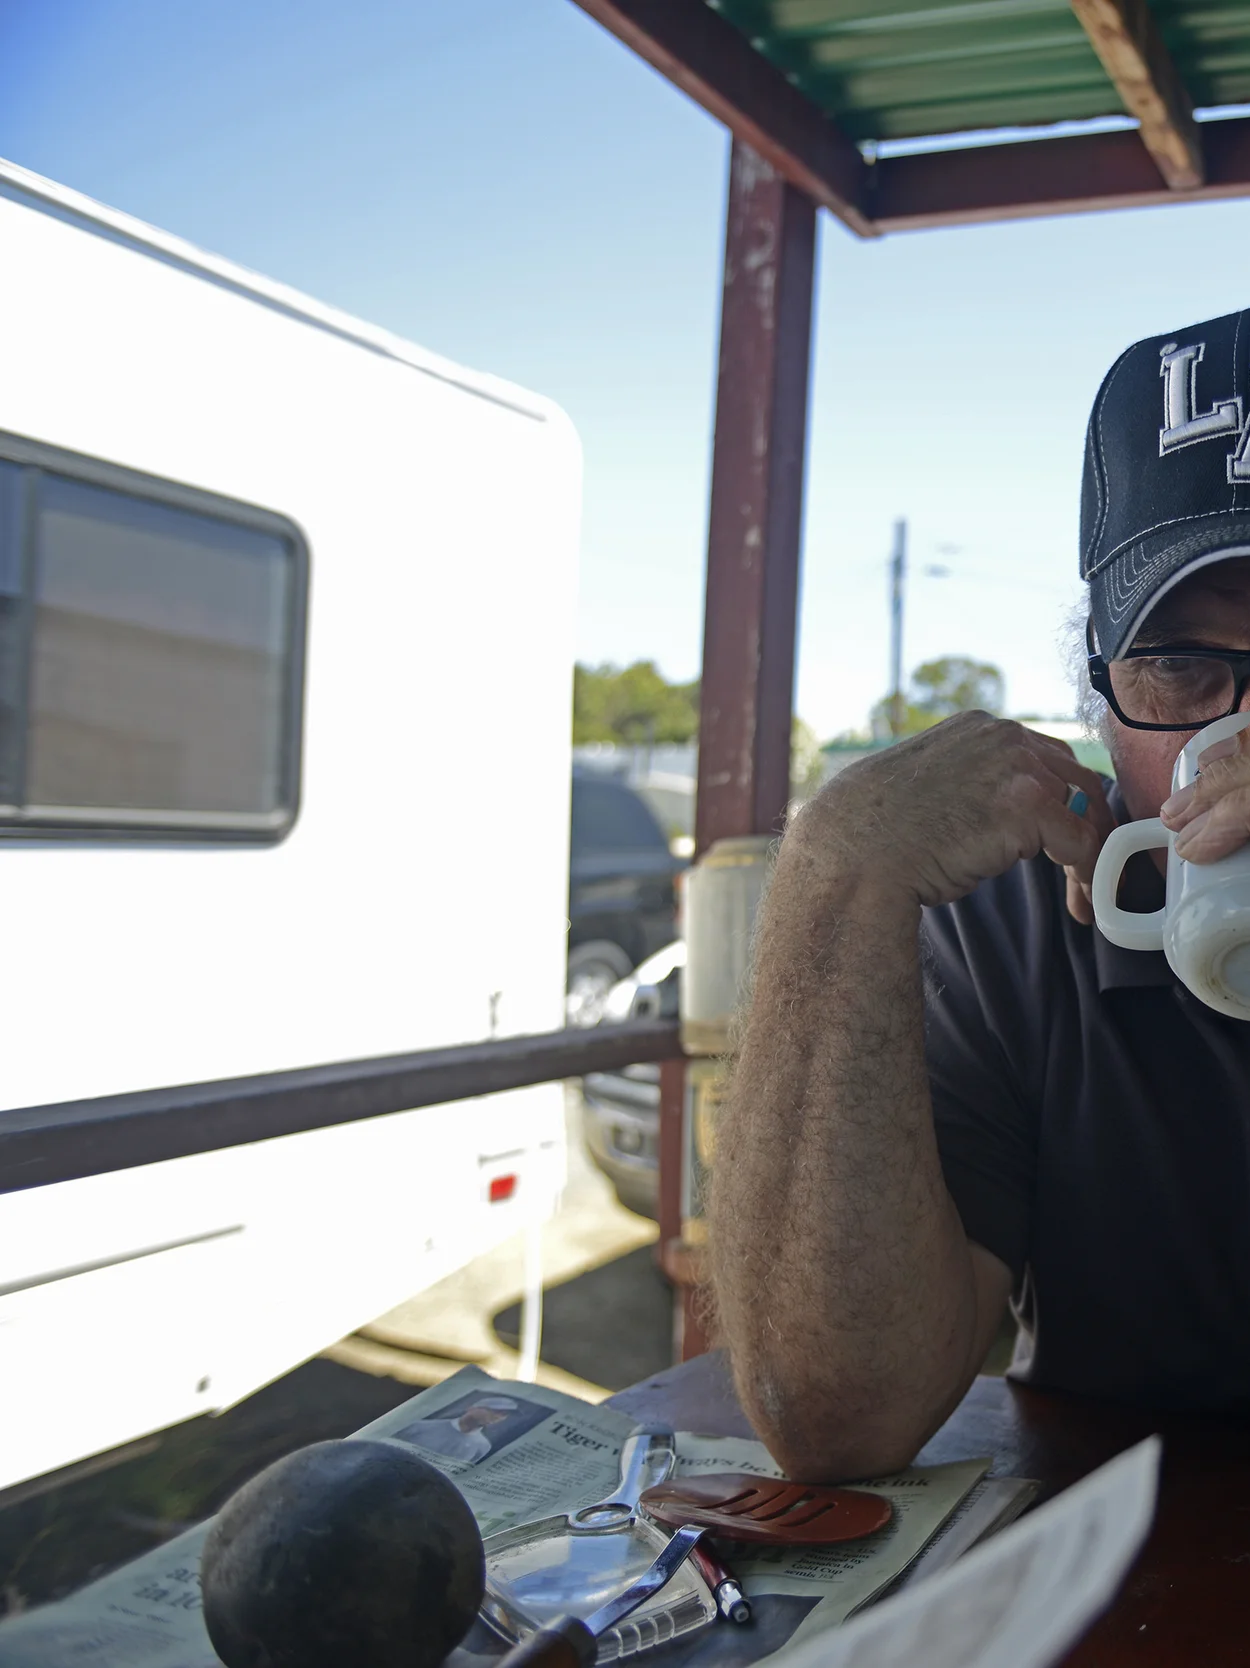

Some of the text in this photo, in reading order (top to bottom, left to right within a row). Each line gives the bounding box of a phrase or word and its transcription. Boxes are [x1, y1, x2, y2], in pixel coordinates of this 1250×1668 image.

[550, 1421, 608, 1451] Tiger
[891, 1479, 930, 1487] ink
[795, 1558, 841, 1567] Jamaica
[784, 1569, 816, 1578] semis
[791, 1563, 843, 1576] Gold Cup
